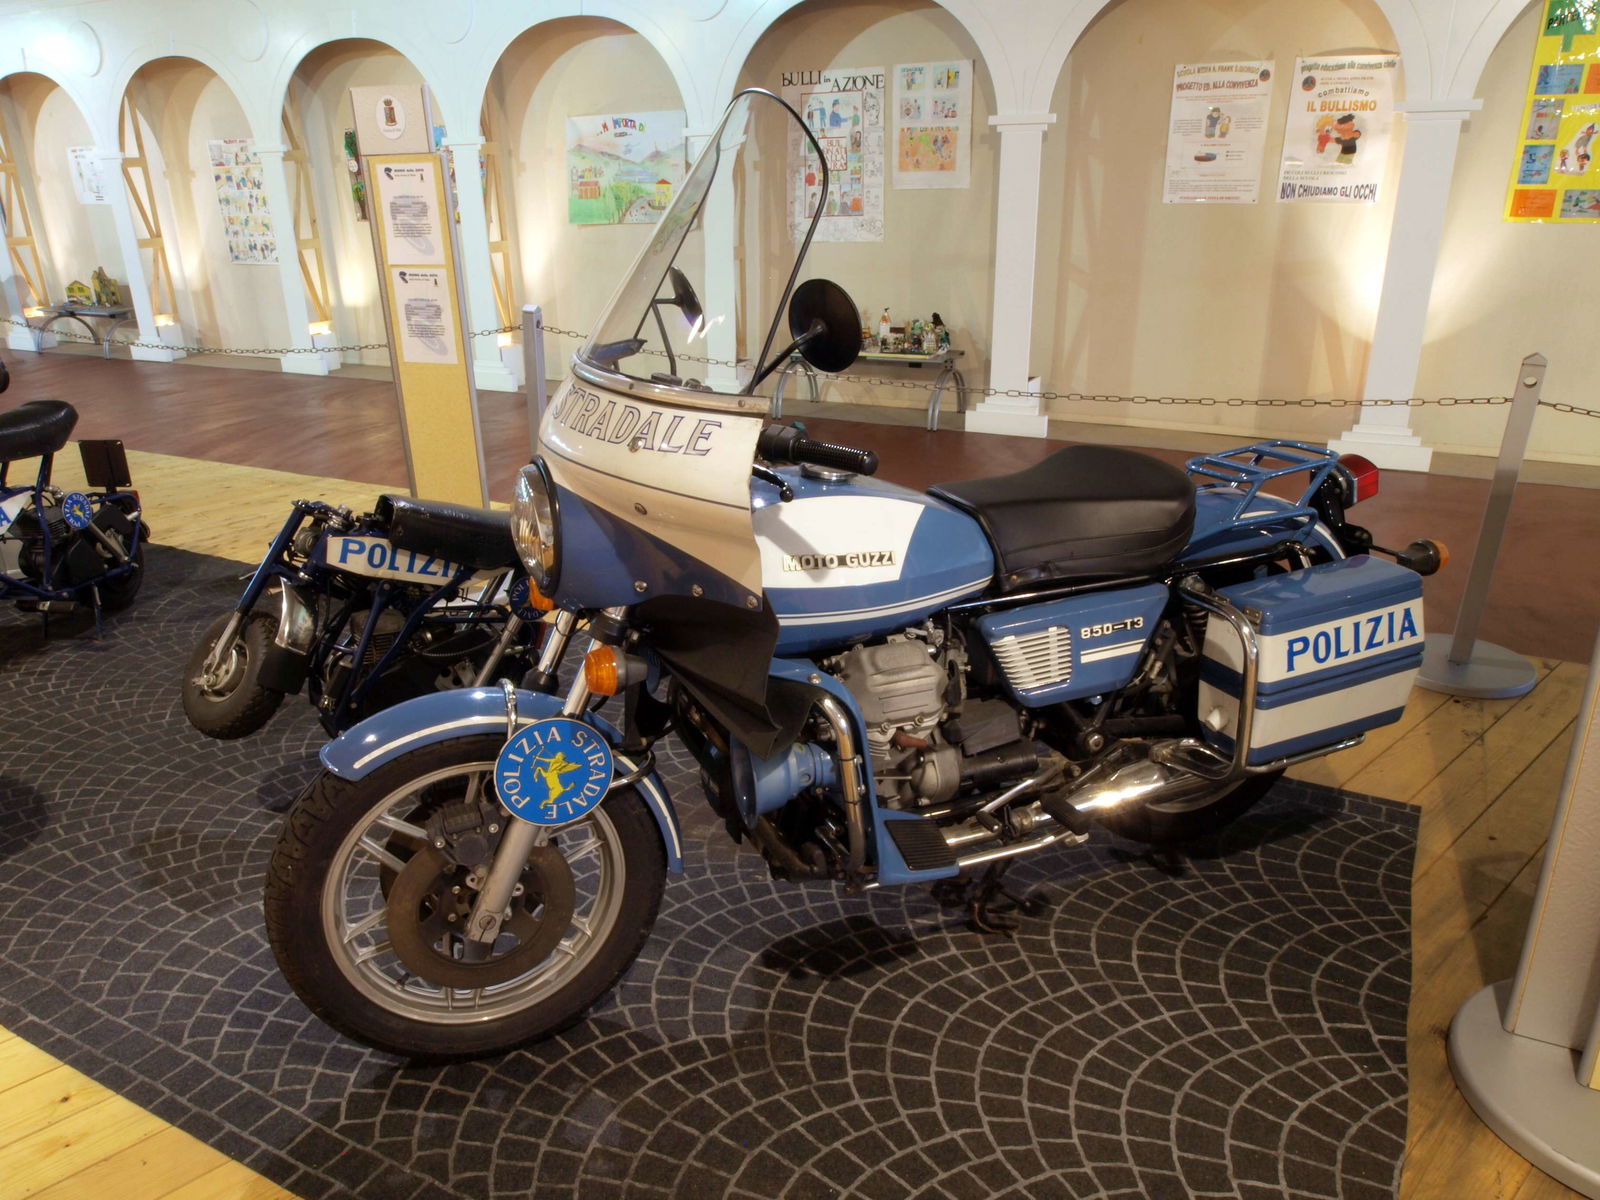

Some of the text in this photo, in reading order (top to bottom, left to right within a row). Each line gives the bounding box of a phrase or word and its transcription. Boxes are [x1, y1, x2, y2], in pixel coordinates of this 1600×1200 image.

[831, 74, 884, 92] AZIONE
[1306, 100, 1377, 112] IL BULLISMO
[1280, 182, 1377, 202] NON CHIUDIAMO GLI OCCHI
[552, 383, 722, 457] STRADALE
[783, 551, 896, 572] MOTO GUZZI
[1080, 616, 1144, 639] 850-T3
[1286, 607, 1418, 673] POLIZIA
[503, 726, 606, 819] POLIZIA STRADALE
